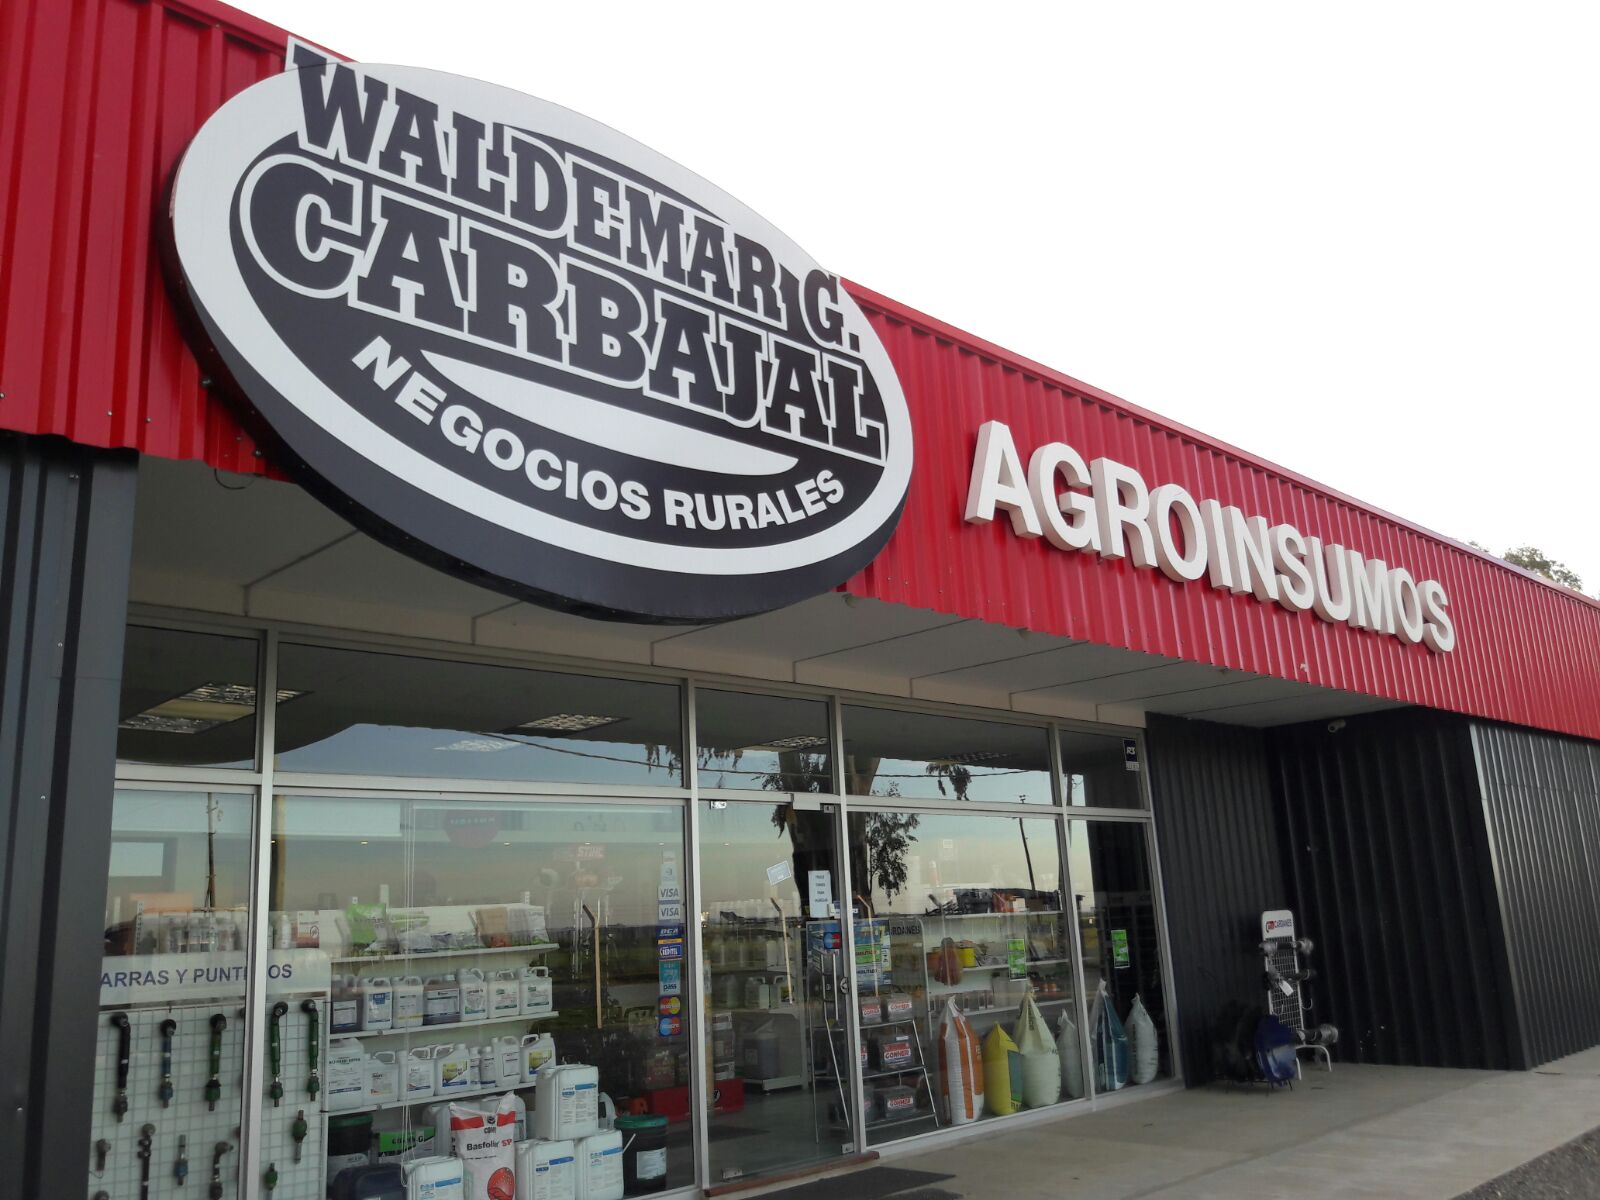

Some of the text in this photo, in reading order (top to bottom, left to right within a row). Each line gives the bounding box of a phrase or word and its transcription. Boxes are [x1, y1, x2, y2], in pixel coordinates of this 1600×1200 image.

[288, 40, 785, 327] WALDEMAR
[241, 154, 887, 464] CARBAJAL
[350, 335, 846, 531] NEGOCIOS RURALES
[964, 419, 1455, 654] AGROINSUMOS
[100, 963, 293, 988] ARRAS Y PUNTOS
[660, 887, 679, 898] VISA
[660, 907, 680, 918] VISA
